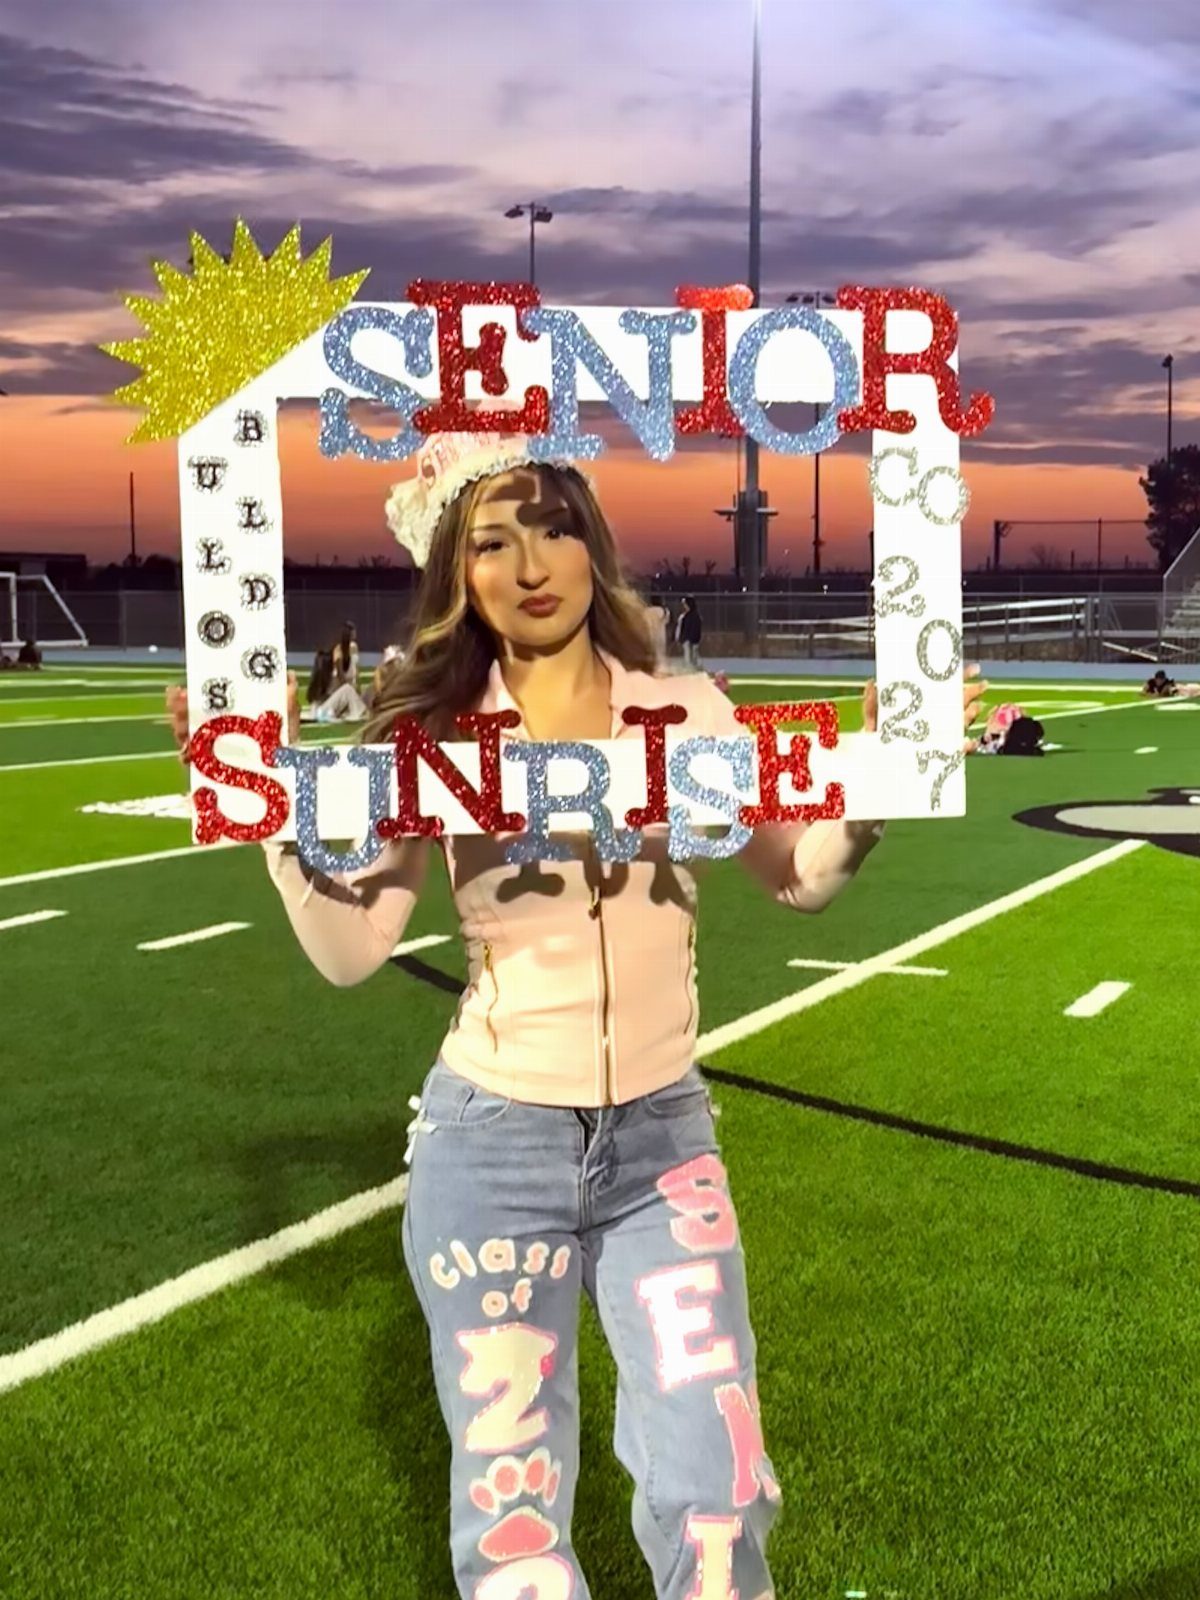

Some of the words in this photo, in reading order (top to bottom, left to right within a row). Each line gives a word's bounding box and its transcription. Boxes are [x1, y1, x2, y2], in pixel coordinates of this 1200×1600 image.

[319, 278, 995, 461] SENIOR
[188, 409, 281, 712] BULLDOGS
[873, 555, 968, 811] 2027
[190, 701, 846, 871] SUNRISE
[481, 1277, 533, 1318] of
